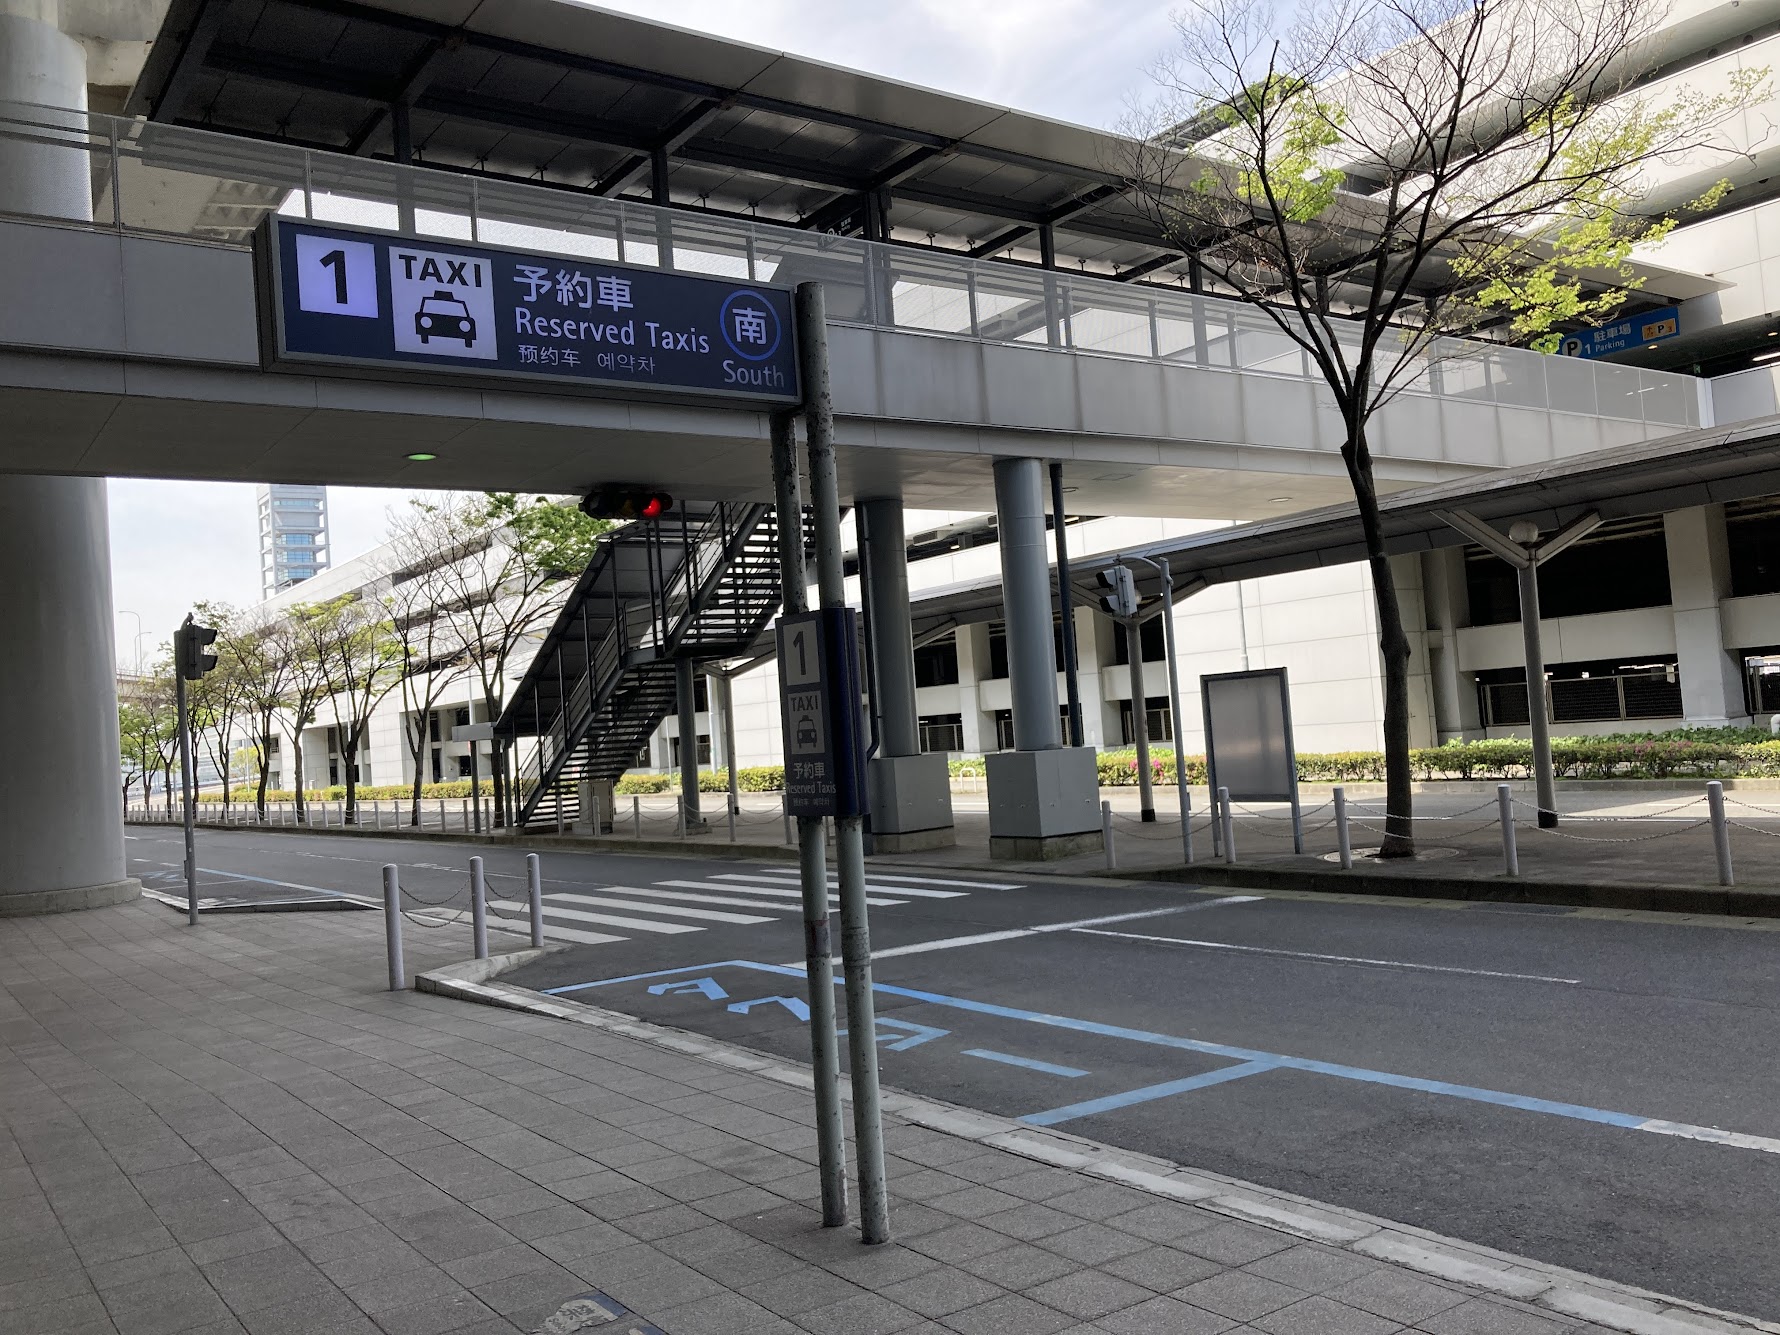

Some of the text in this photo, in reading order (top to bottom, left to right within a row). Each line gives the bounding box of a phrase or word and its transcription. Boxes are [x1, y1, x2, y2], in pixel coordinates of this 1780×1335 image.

[319, 250, 348, 305] 1
[399, 254, 483, 288] TAXI
[513, 265, 634, 311] 予約車
[515, 308, 710, 354] Reserved Taxis
[734, 308, 767, 343] 南
[1594, 324, 1631, 343] 駐車場
[518, 345, 656, 375] 预约车 예약차
[1595, 340, 1625, 353] Parking
[723, 360, 784, 388] South
[793, 631, 806, 675] 1
[790, 695, 818, 711] TAXI
[793, 762, 825, 779] 予約車
[786, 781, 836, 794] Reserved Taxis
